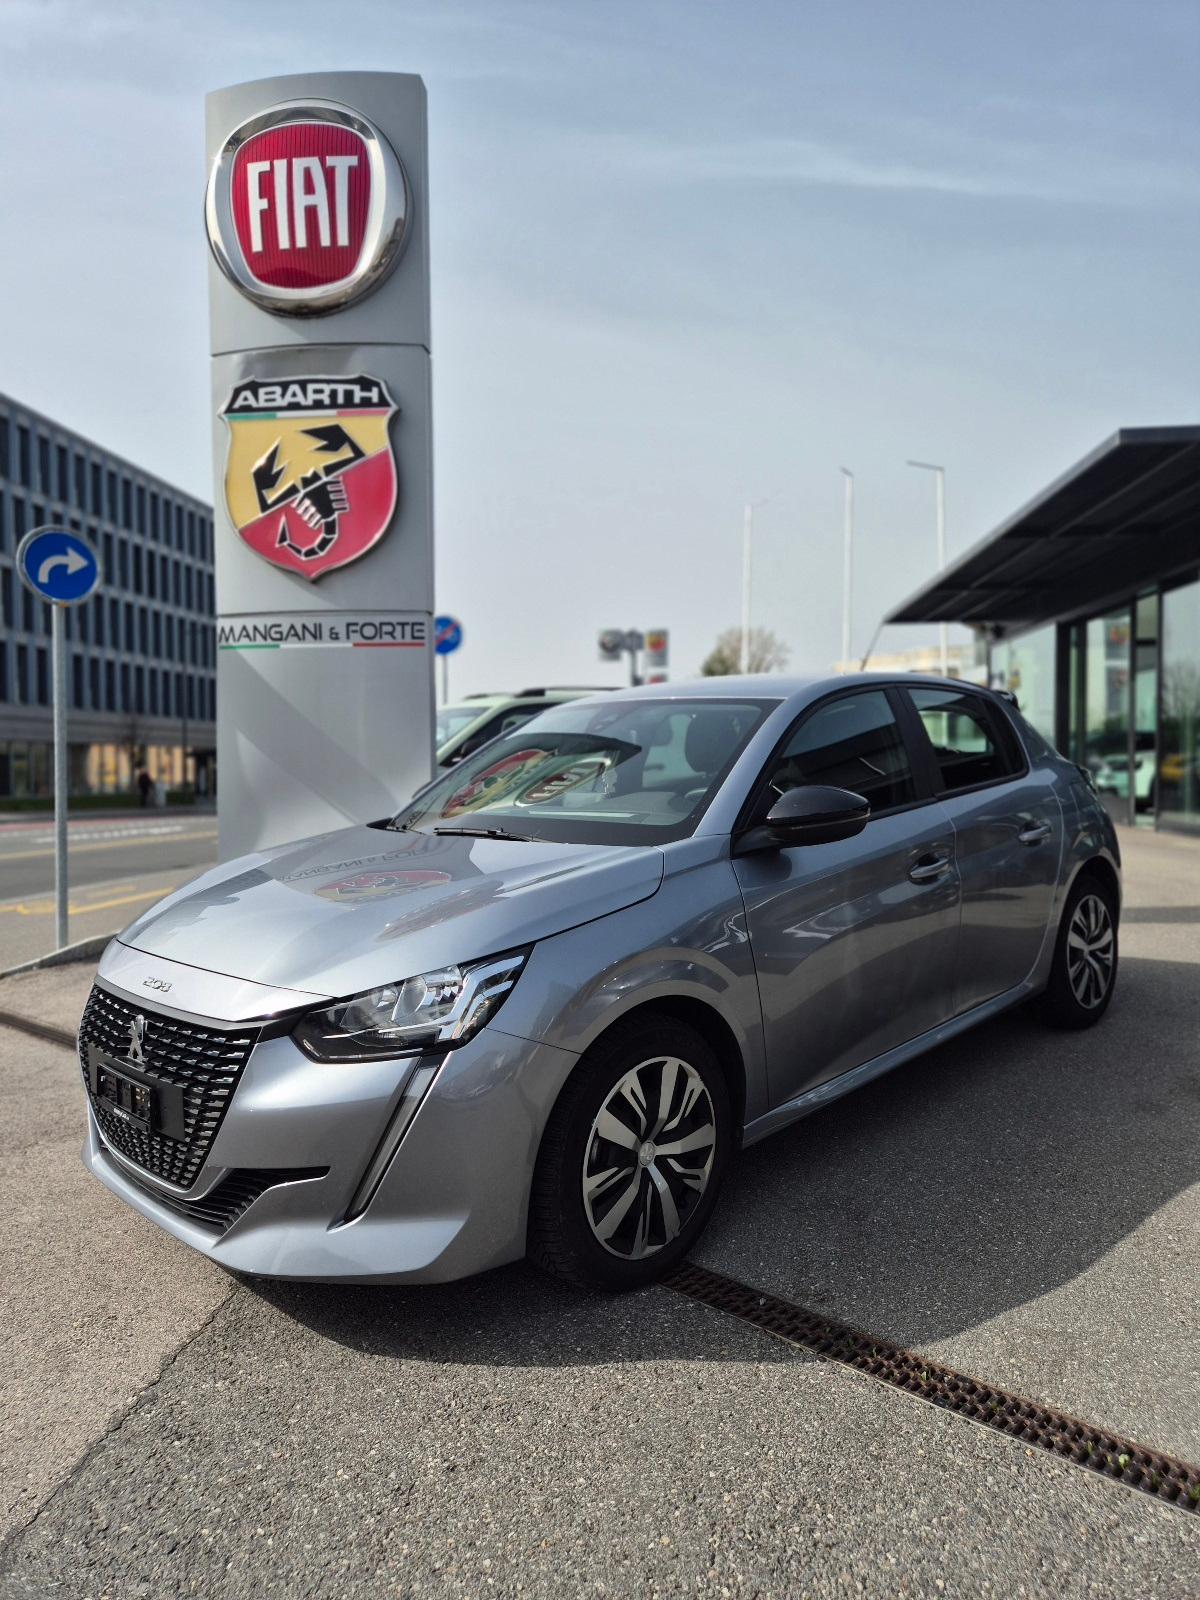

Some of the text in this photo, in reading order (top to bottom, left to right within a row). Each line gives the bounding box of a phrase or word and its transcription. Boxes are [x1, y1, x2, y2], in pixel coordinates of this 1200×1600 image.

[247, 155, 359, 253] FIAT
[232, 383, 379, 409] ABARTH
[218, 622, 425, 642] MANGANI & FORTE
[143, 976, 173, 992] 208
